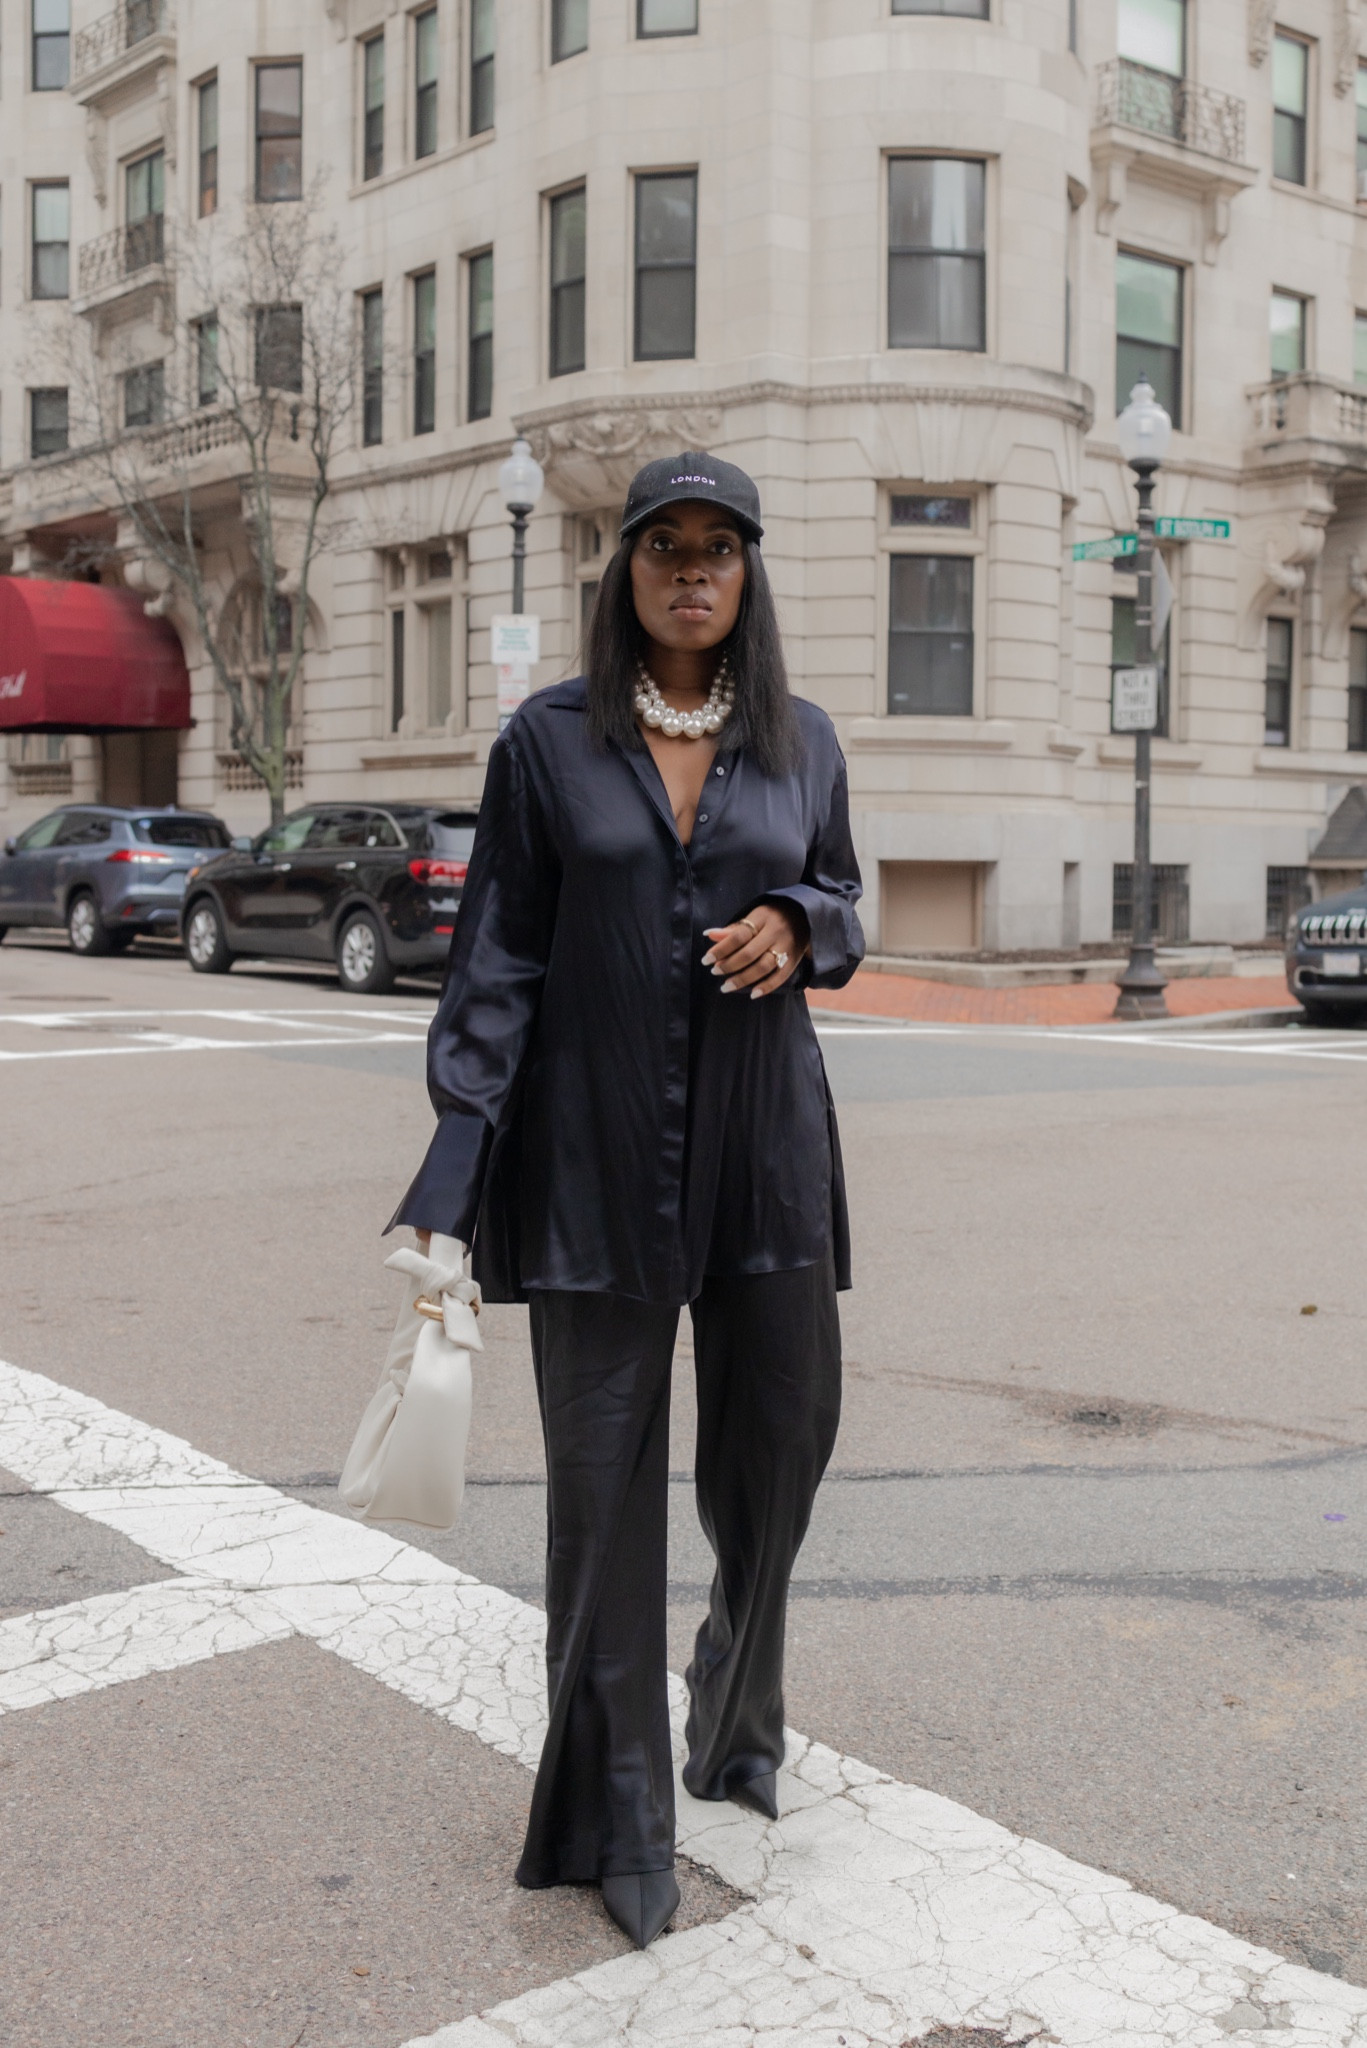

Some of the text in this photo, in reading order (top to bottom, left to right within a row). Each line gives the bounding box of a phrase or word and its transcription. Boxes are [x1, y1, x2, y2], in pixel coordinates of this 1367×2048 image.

[671, 475, 716, 486] LONDON
[1122, 673, 1150, 688] NOT A
[1123, 691, 1149, 705] THRU
[1117, 708, 1153, 726] STREET
